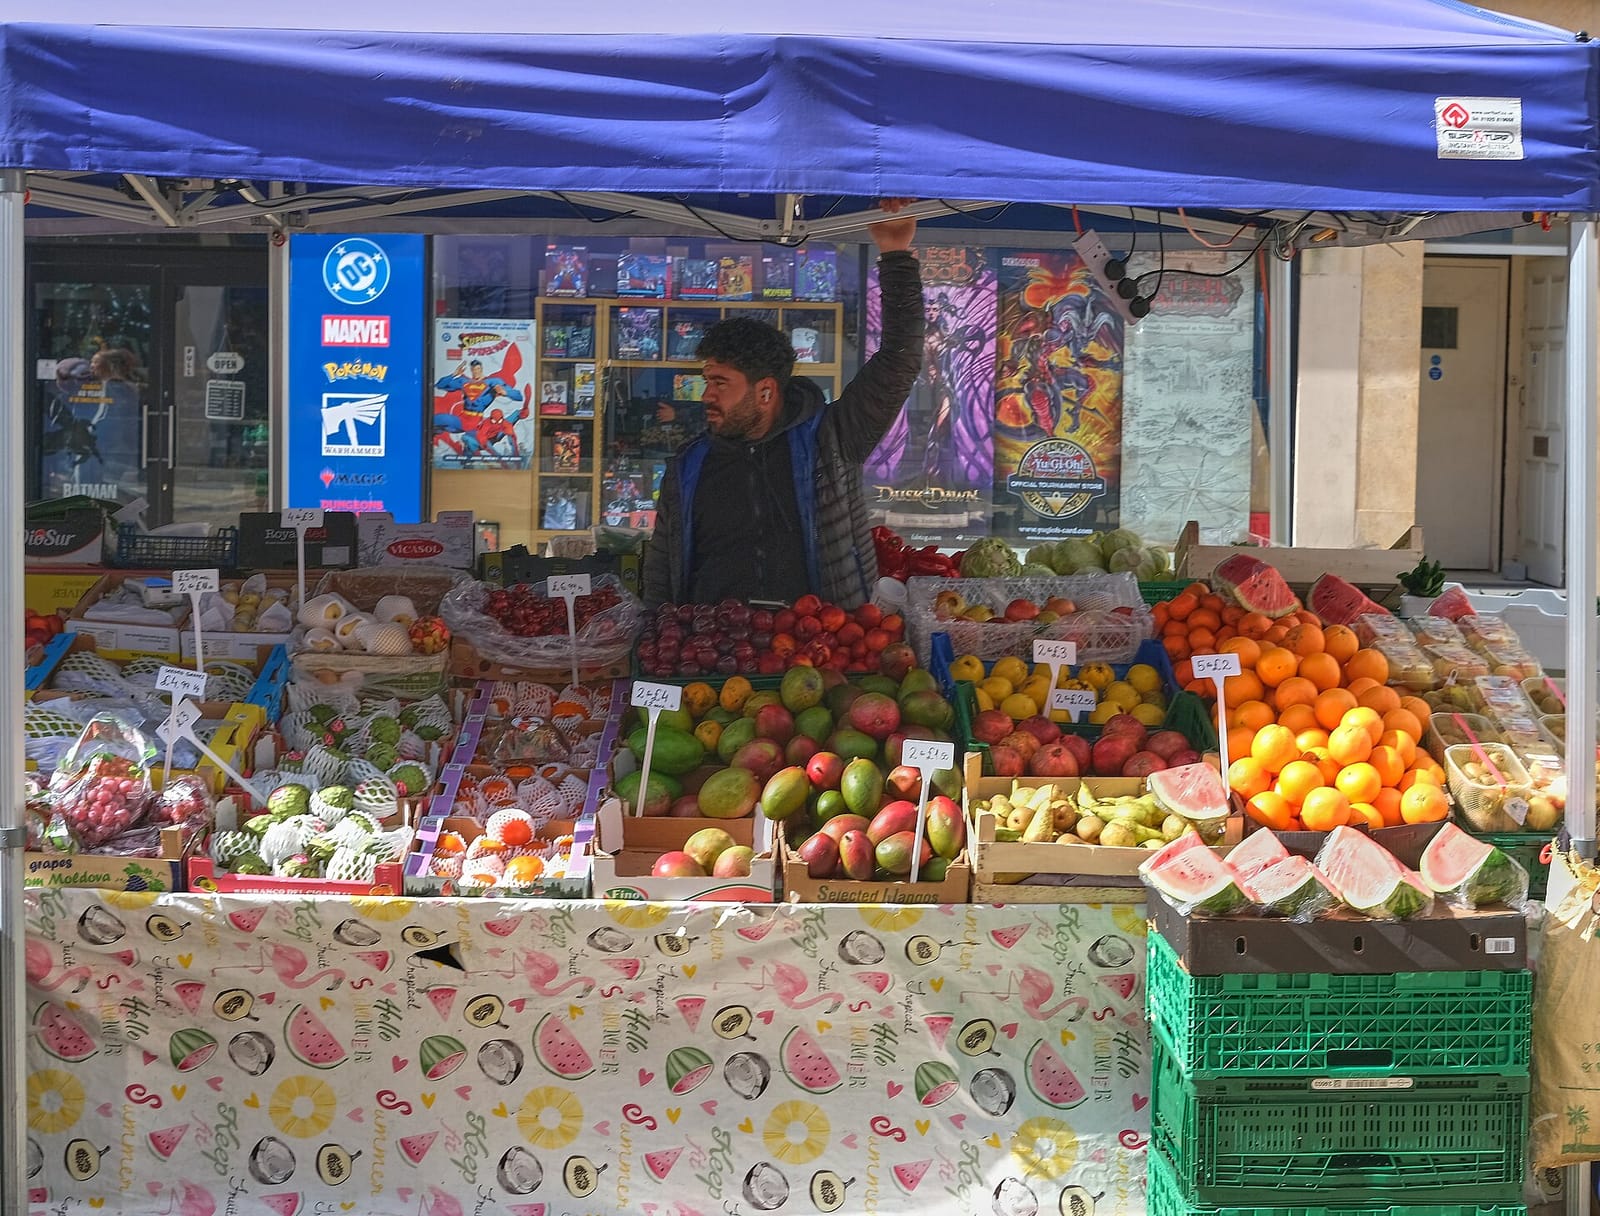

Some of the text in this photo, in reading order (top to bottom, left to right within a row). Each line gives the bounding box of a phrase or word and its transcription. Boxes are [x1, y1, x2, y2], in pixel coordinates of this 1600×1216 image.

[340, 255, 372, 287] DC
[921, 262, 973, 281] OOD
[324, 318, 388, 344] MARVEL
[214, 360, 238, 370] OPEN
[324, 446, 384, 455] WARHAMMER
[63, 483, 118, 499] BATMAN
[334, 473, 386, 486] MAGIC
[1010, 480, 1103, 490] OFFICIAL TOURNAMENT STORE
[320, 500, 384, 510] DUNGEONS
[264, 529, 299, 541] Roya
[391, 543, 440, 554] VICASOL
[29, 858, 73, 874] grapes
[47, 871, 112, 886] Moldova
[611, 889, 641, 900] Fino
[816, 885, 880, 903] Selected
[282, 897, 323, 943] Keep
[790, 908, 829, 959] Keep
[1040, 904, 1081, 962] Keep
[316, 941, 338, 968] Fruit
[568, 947, 590, 976] Fruit
[399, 953, 428, 1010] Tropical
[648, 962, 679, 1018] Tropical
[817, 958, 839, 991] Fruit
[1062, 960, 1087, 997] Fruit
[120, 996, 151, 1041] Hello
[372, 998, 402, 1042] Hello
[897, 979, 927, 1035] Tropical
[620, 1007, 651, 1053] Hello
[869, 1022, 899, 1067] Hello
[1113, 1029, 1142, 1079] Hello
[200, 1102, 241, 1177] Keep
[449, 1110, 490, 1185] Keep
[695, 1126, 735, 1201] Keep
